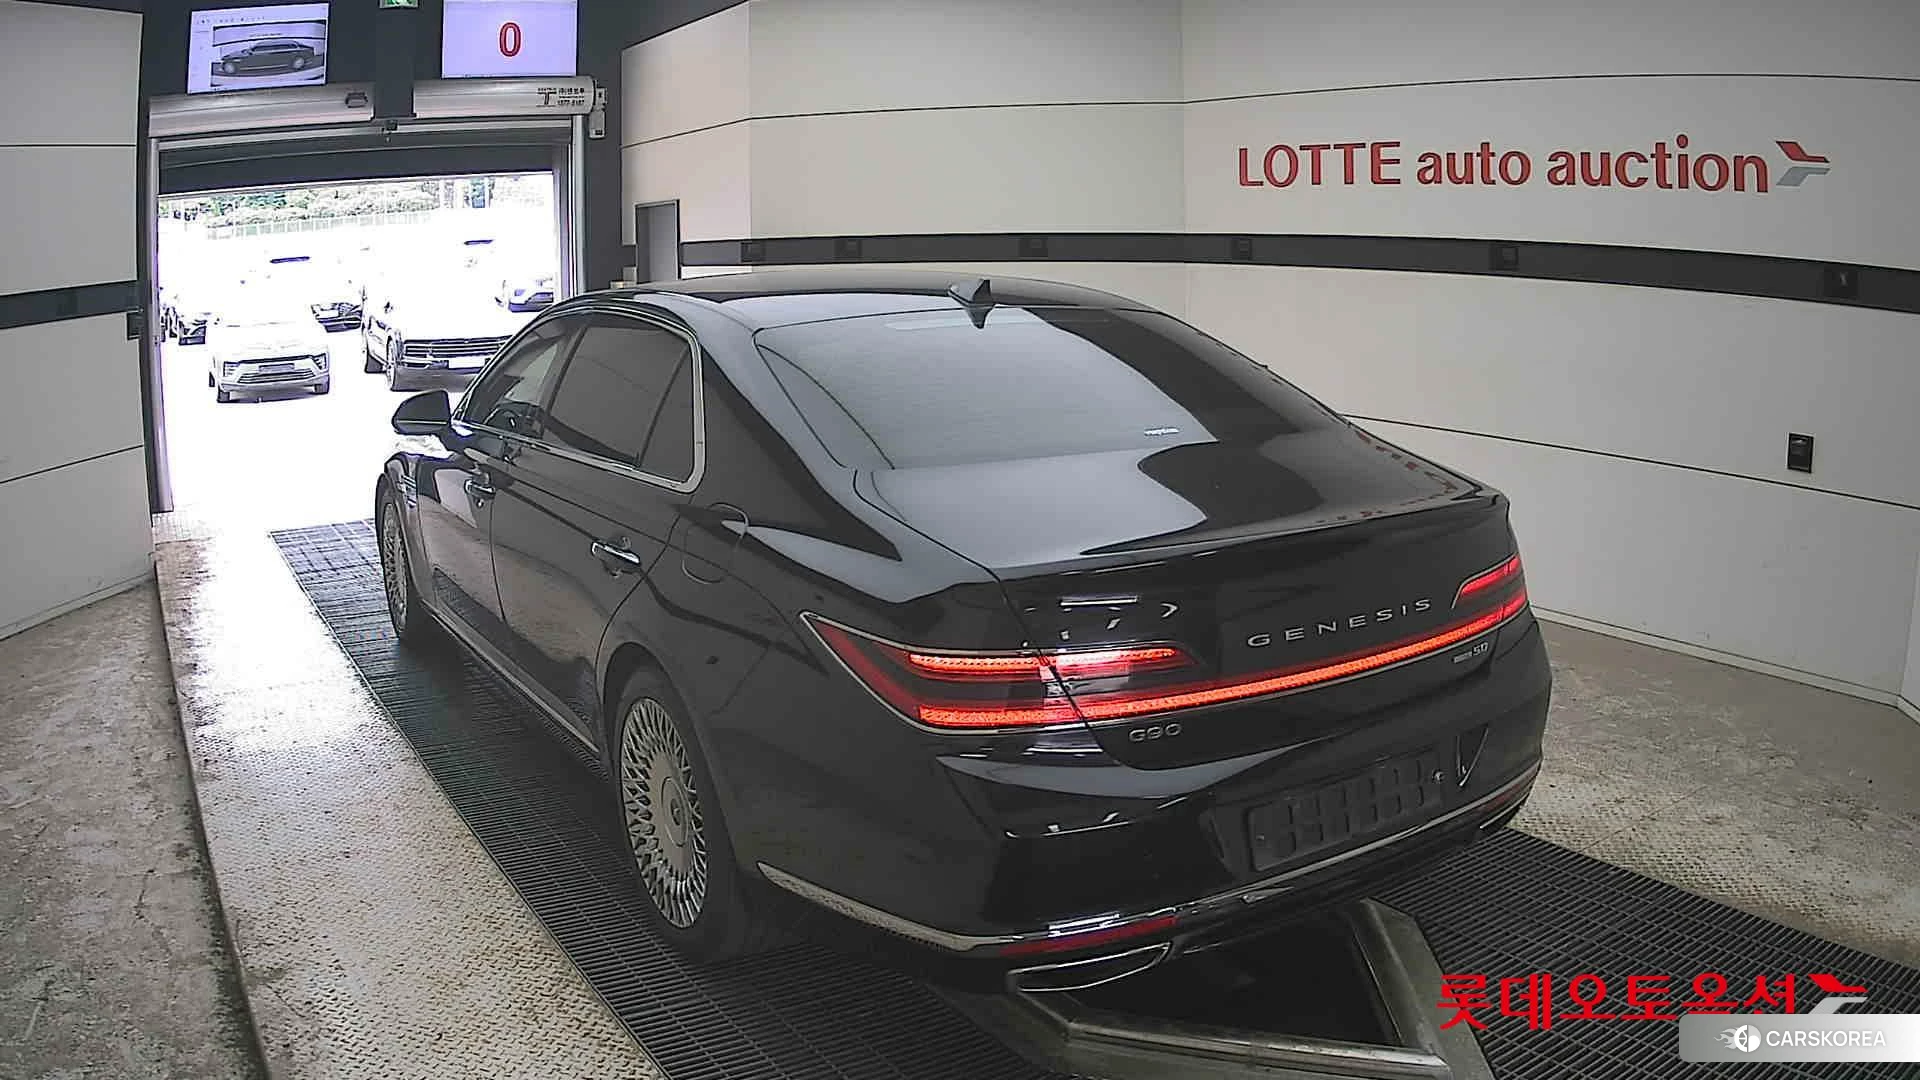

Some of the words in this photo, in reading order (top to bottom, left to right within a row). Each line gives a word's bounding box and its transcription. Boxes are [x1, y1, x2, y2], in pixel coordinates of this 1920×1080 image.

[499, 22, 521, 57] 0
[1239, 141, 1400, 188] LOTTE
[1417, 141, 1531, 186] auto
[1547, 135, 1769, 192] auction
[1247, 598, 1432, 647] GENESIS
[1128, 722, 1182, 742] G90
